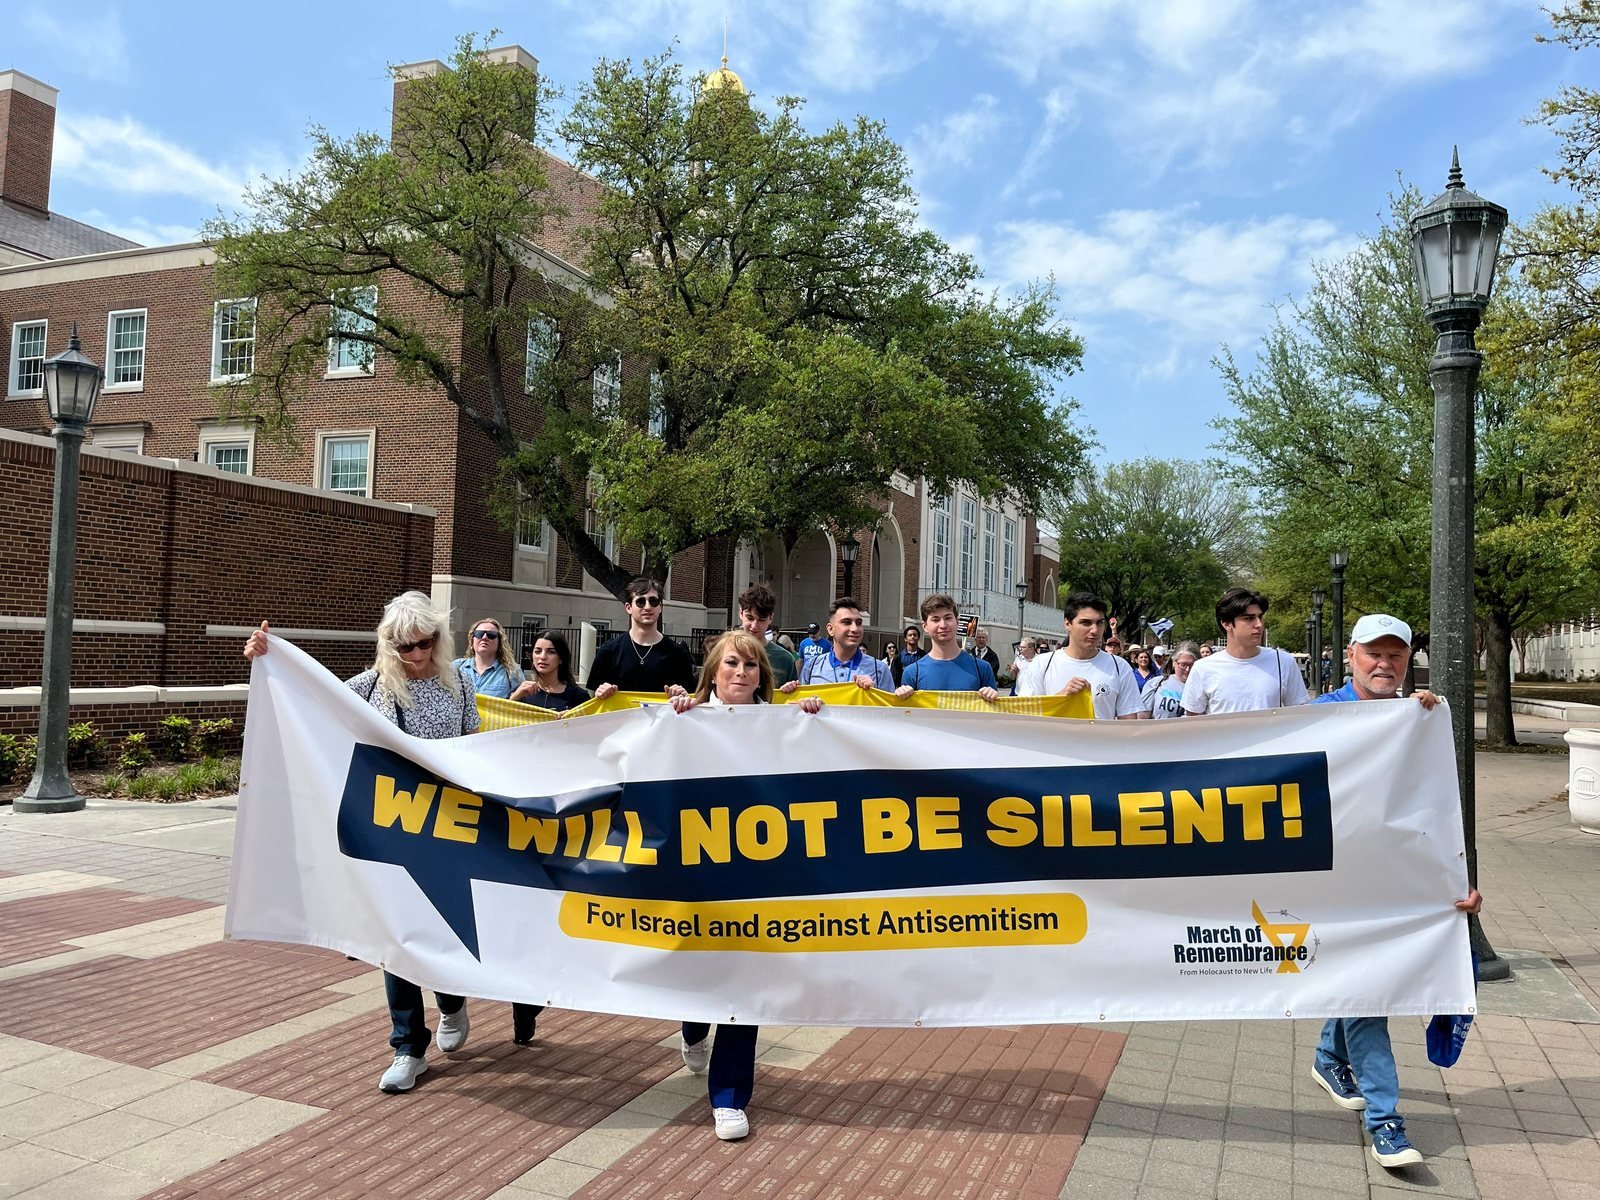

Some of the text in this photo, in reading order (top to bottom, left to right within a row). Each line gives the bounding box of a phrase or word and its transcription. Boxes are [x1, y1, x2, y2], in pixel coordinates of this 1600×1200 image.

[373, 774, 1303, 866] WE WILL NOT BE SILENT!
[587, 901, 1059, 943] For Israel and against Antisemitism
[1187, 925, 1262, 944] March of
[1173, 943, 1308, 964] Remembrance
[1199, 968, 1234, 976] Holocaust
